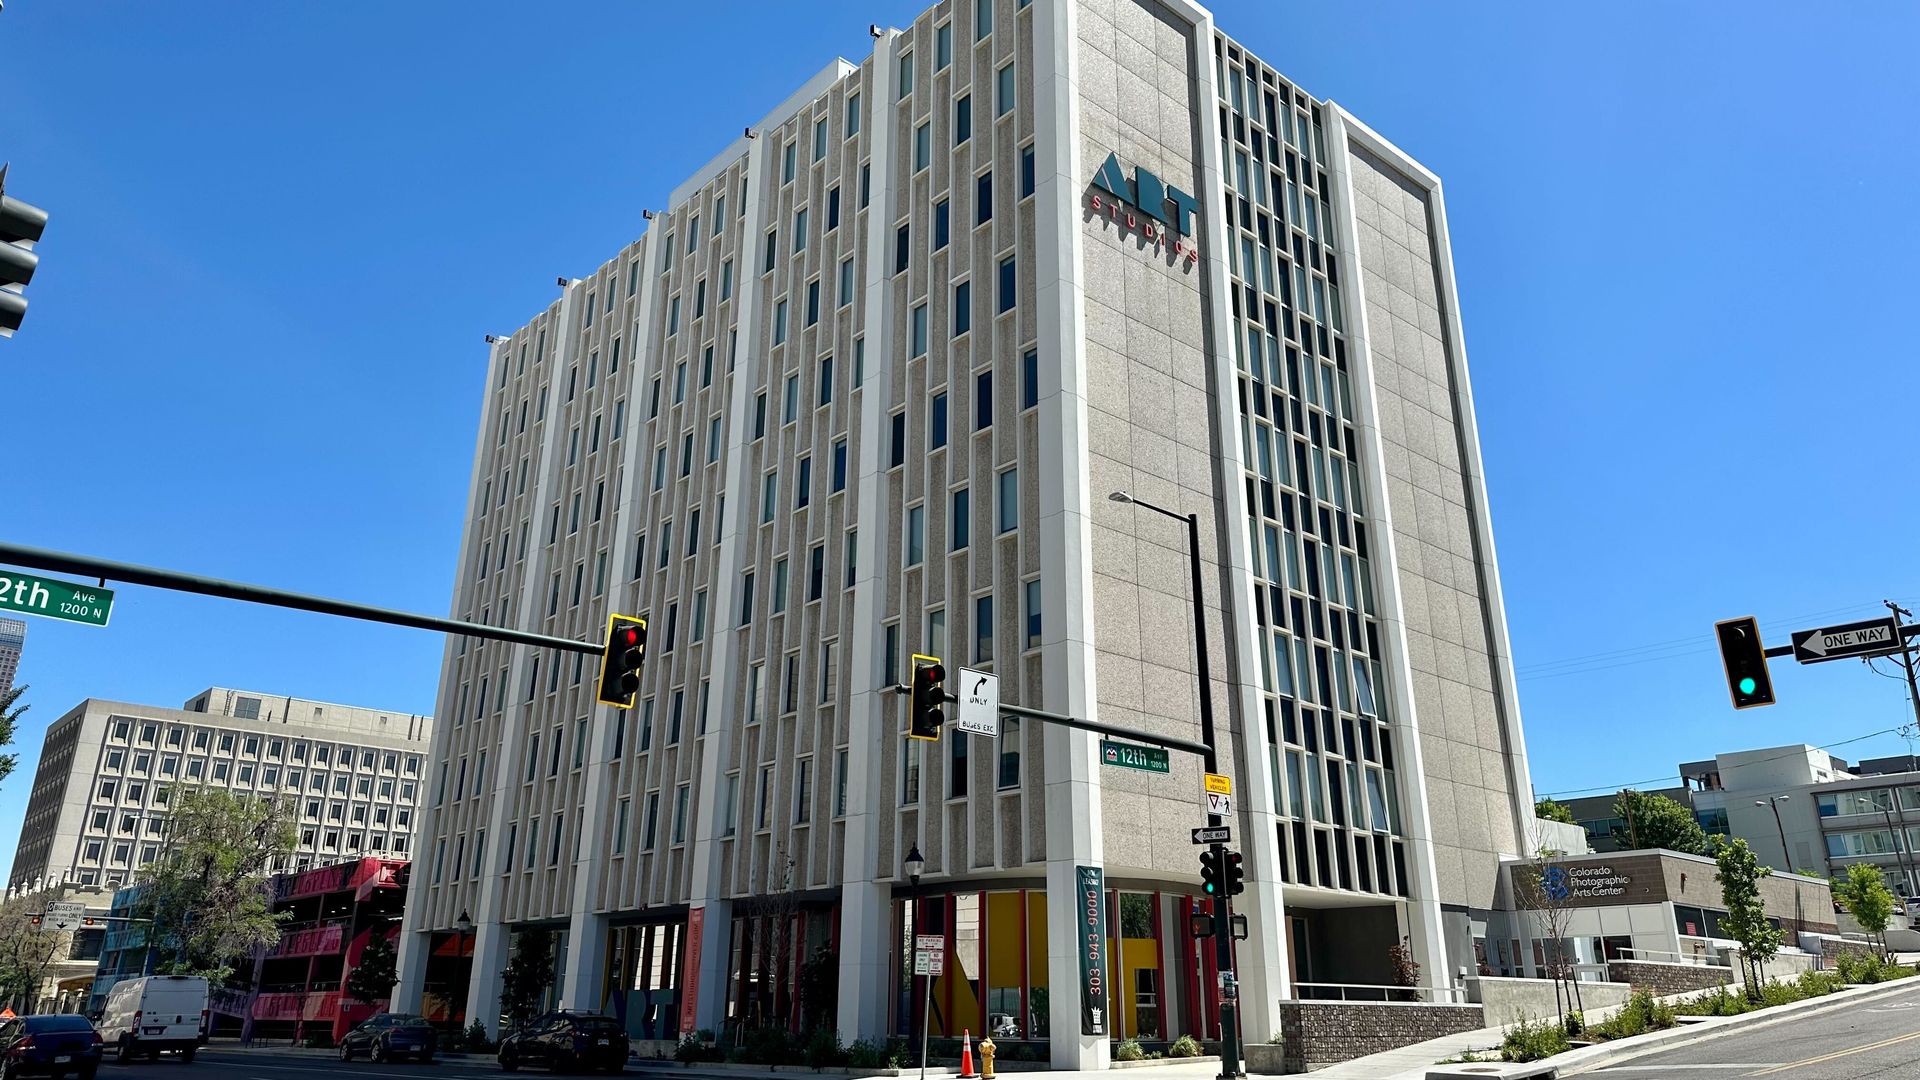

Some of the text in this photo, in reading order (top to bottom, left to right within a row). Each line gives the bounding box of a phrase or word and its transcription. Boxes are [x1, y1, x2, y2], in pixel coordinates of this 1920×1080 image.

[1092, 151, 1199, 237] ART
[1092, 195, 1199, 263] STUDIOS
[73, 590, 96, 603] Ave
[60, 602, 102, 618] 1200 N
[1824, 628, 1885, 647] ONE WAY
[970, 697, 988, 705] ONLY
[1120, 747, 1147, 766] 12th
[1150, 760, 1162, 769] 1200
[1569, 866, 1611, 877] Colorado
[1570, 875, 1630, 888] Photographic
[1573, 886, 1624, 897] Arts Center
[1086, 890, 1102, 995] 303-943-9000
